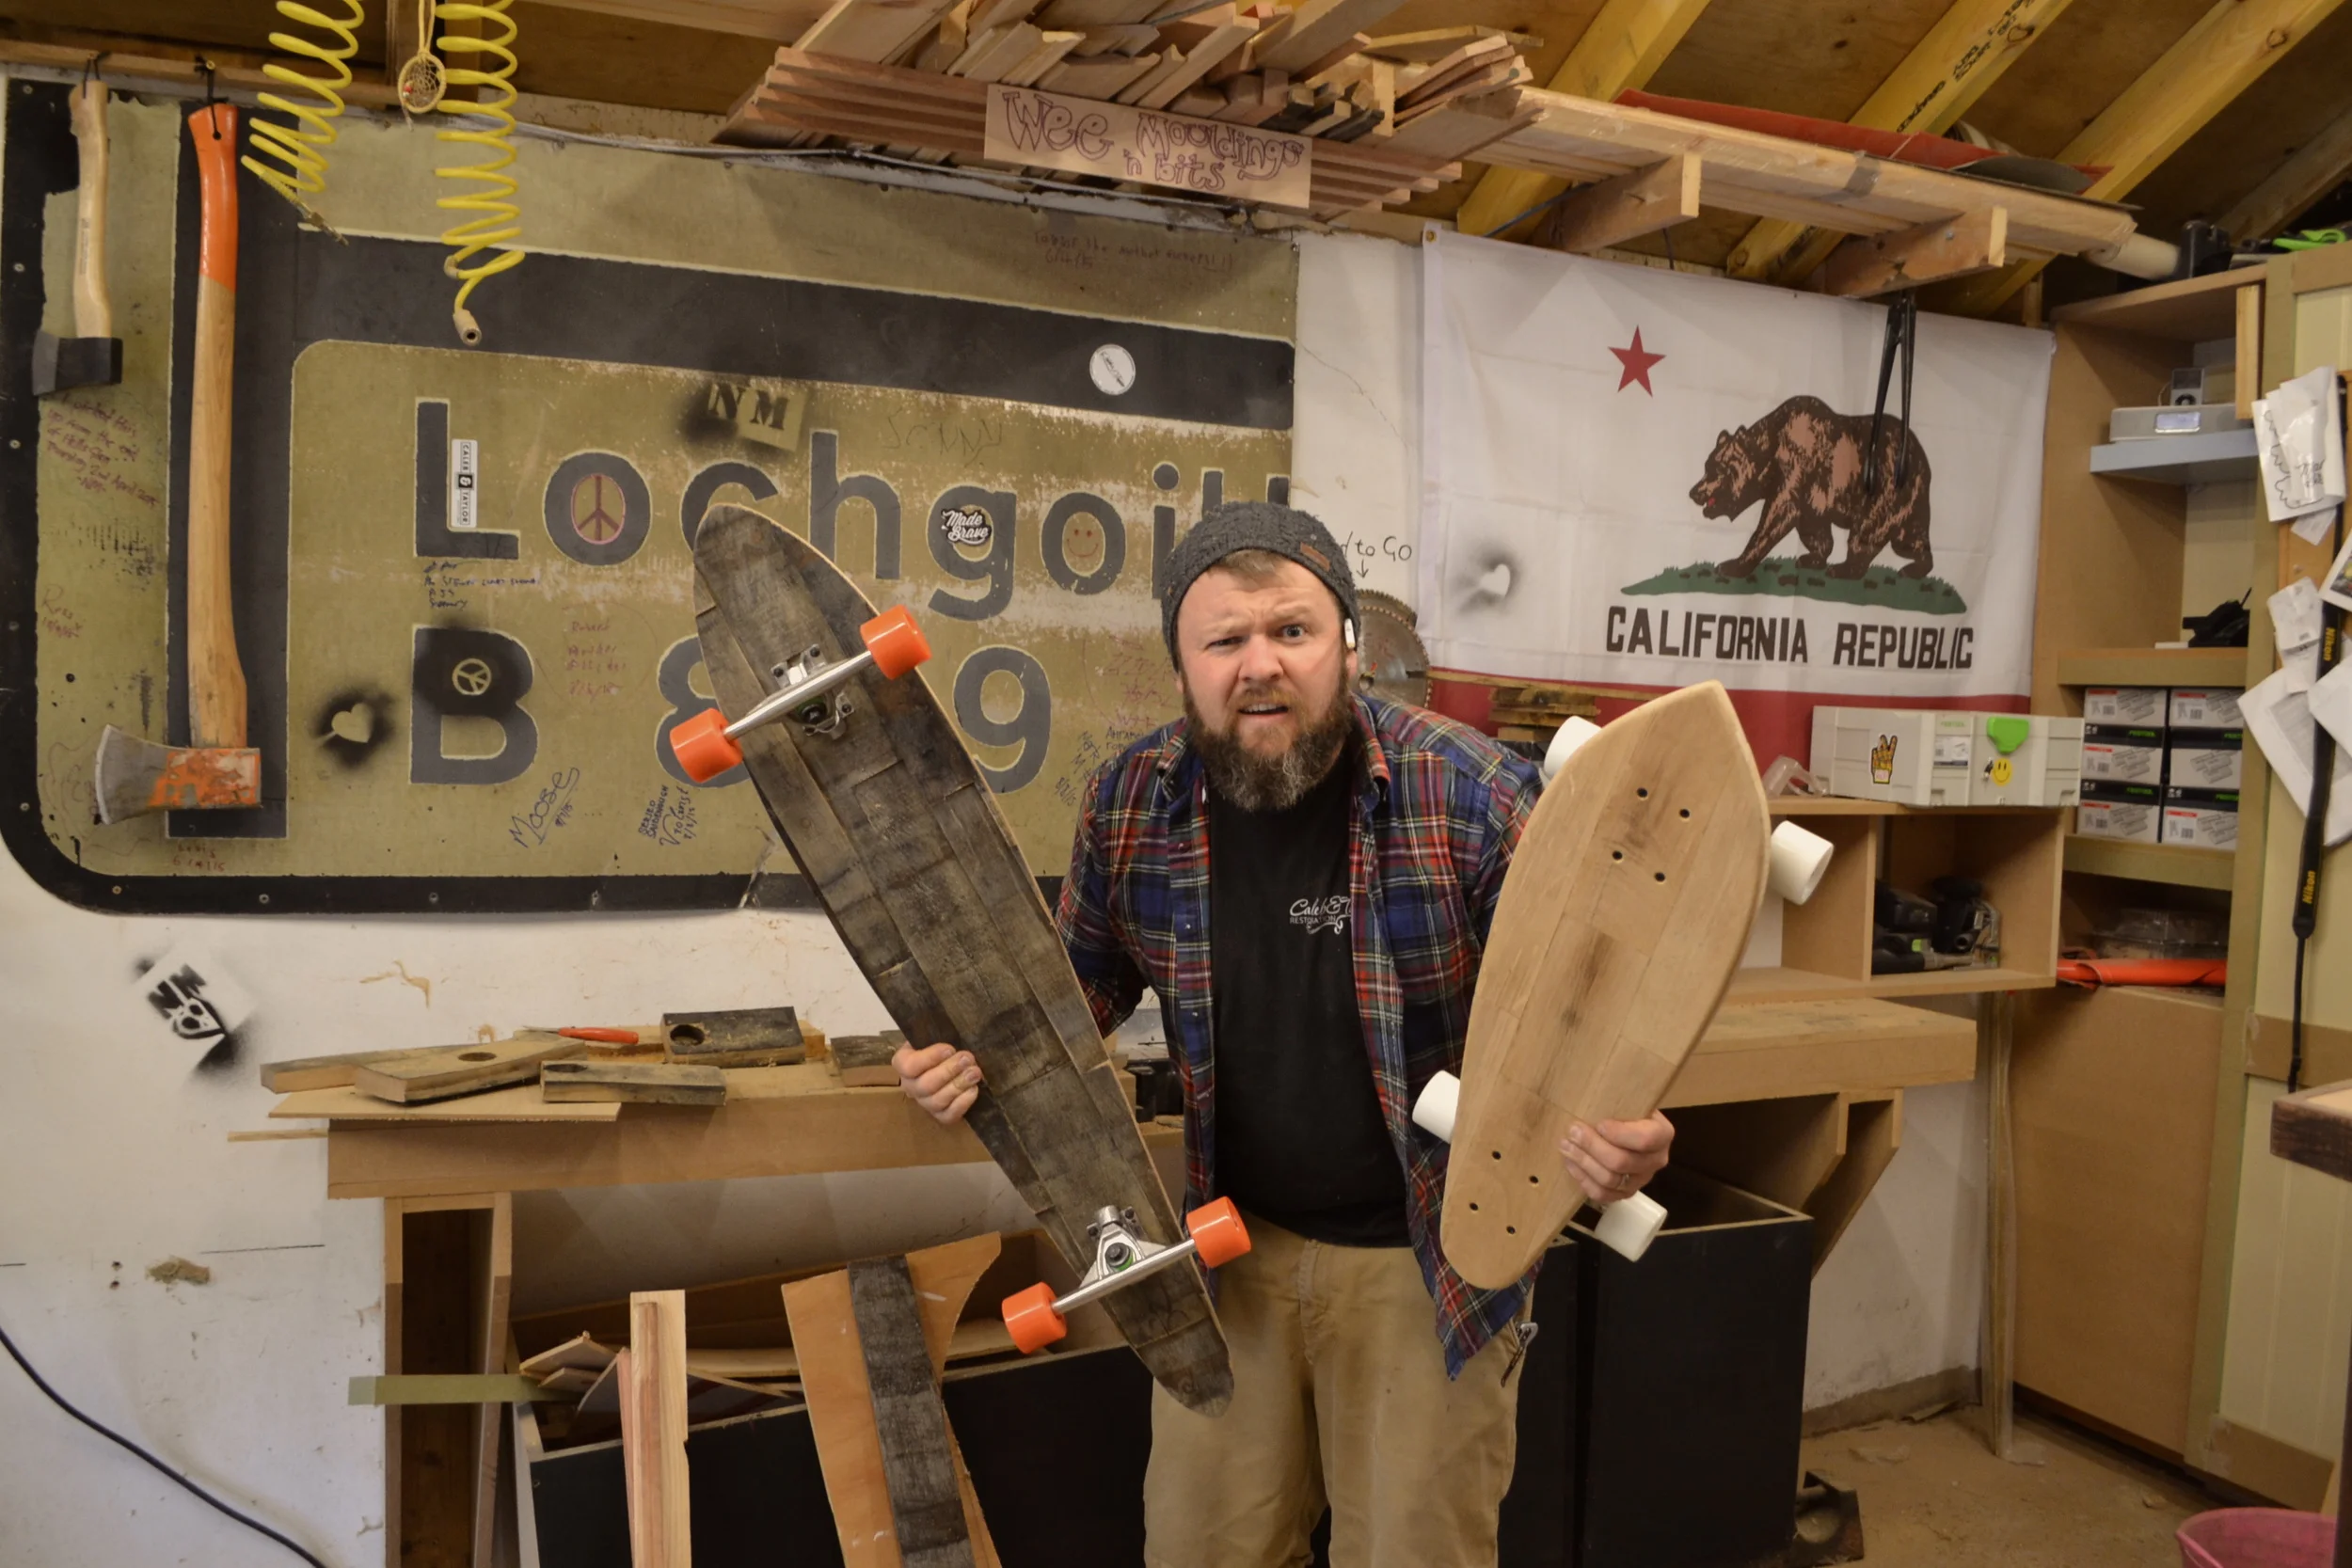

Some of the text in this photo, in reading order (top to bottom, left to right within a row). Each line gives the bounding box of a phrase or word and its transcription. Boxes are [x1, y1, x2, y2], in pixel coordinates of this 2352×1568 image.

[1003, 91, 1305, 181] Wee Mouldings
[1154, 152, 1225, 191] bits
[942, 510, 984, 528] Made
[947, 523, 990, 545] Brave
[1355, 539, 1375, 557] to
[1606, 606, 1973, 670] CALIFORNIA REPUBLIC
[655, 633, 1052, 794] 89
[508, 767, 580, 848] Moose
[2302, 870, 2315, 904] Nikon
[1290, 897, 1327, 916] Caleb
